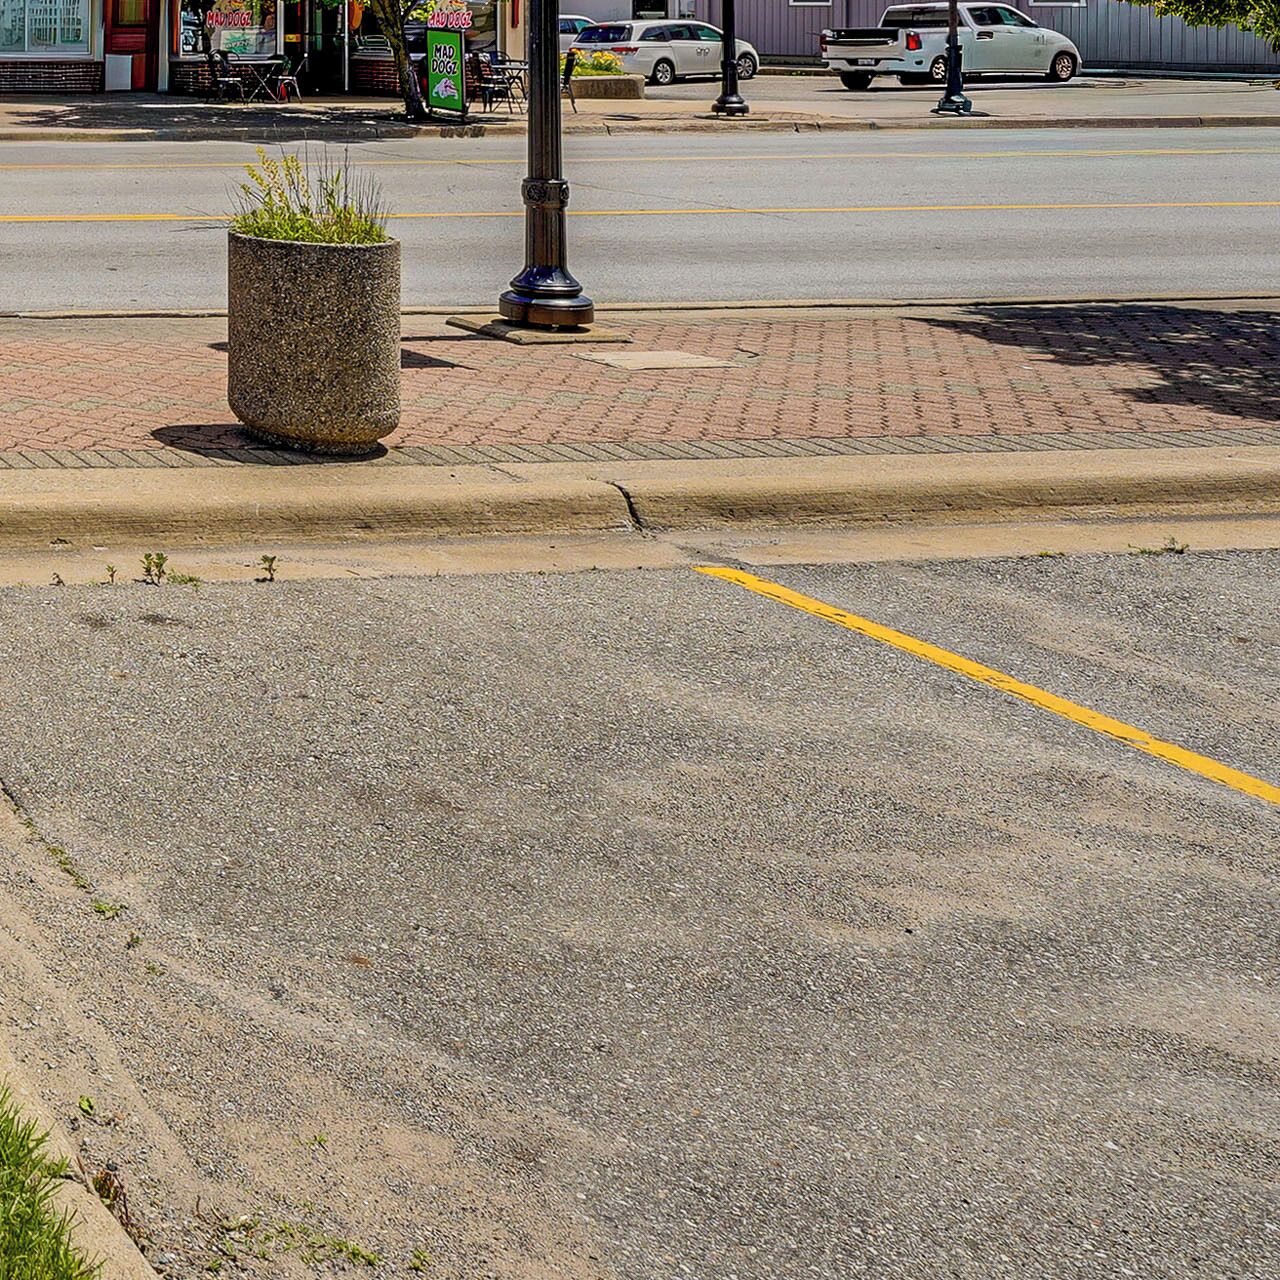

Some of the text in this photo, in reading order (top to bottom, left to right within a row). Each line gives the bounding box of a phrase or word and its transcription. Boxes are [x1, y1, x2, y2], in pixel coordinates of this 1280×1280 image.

[207, 10, 252, 28] MAD DOGZ
[427, 11, 473, 28] MAD DOGZ
[225, 39, 249, 48] OPEN
[433, 43, 456, 60] MAD
[431, 59, 459, 76] DOGZ
